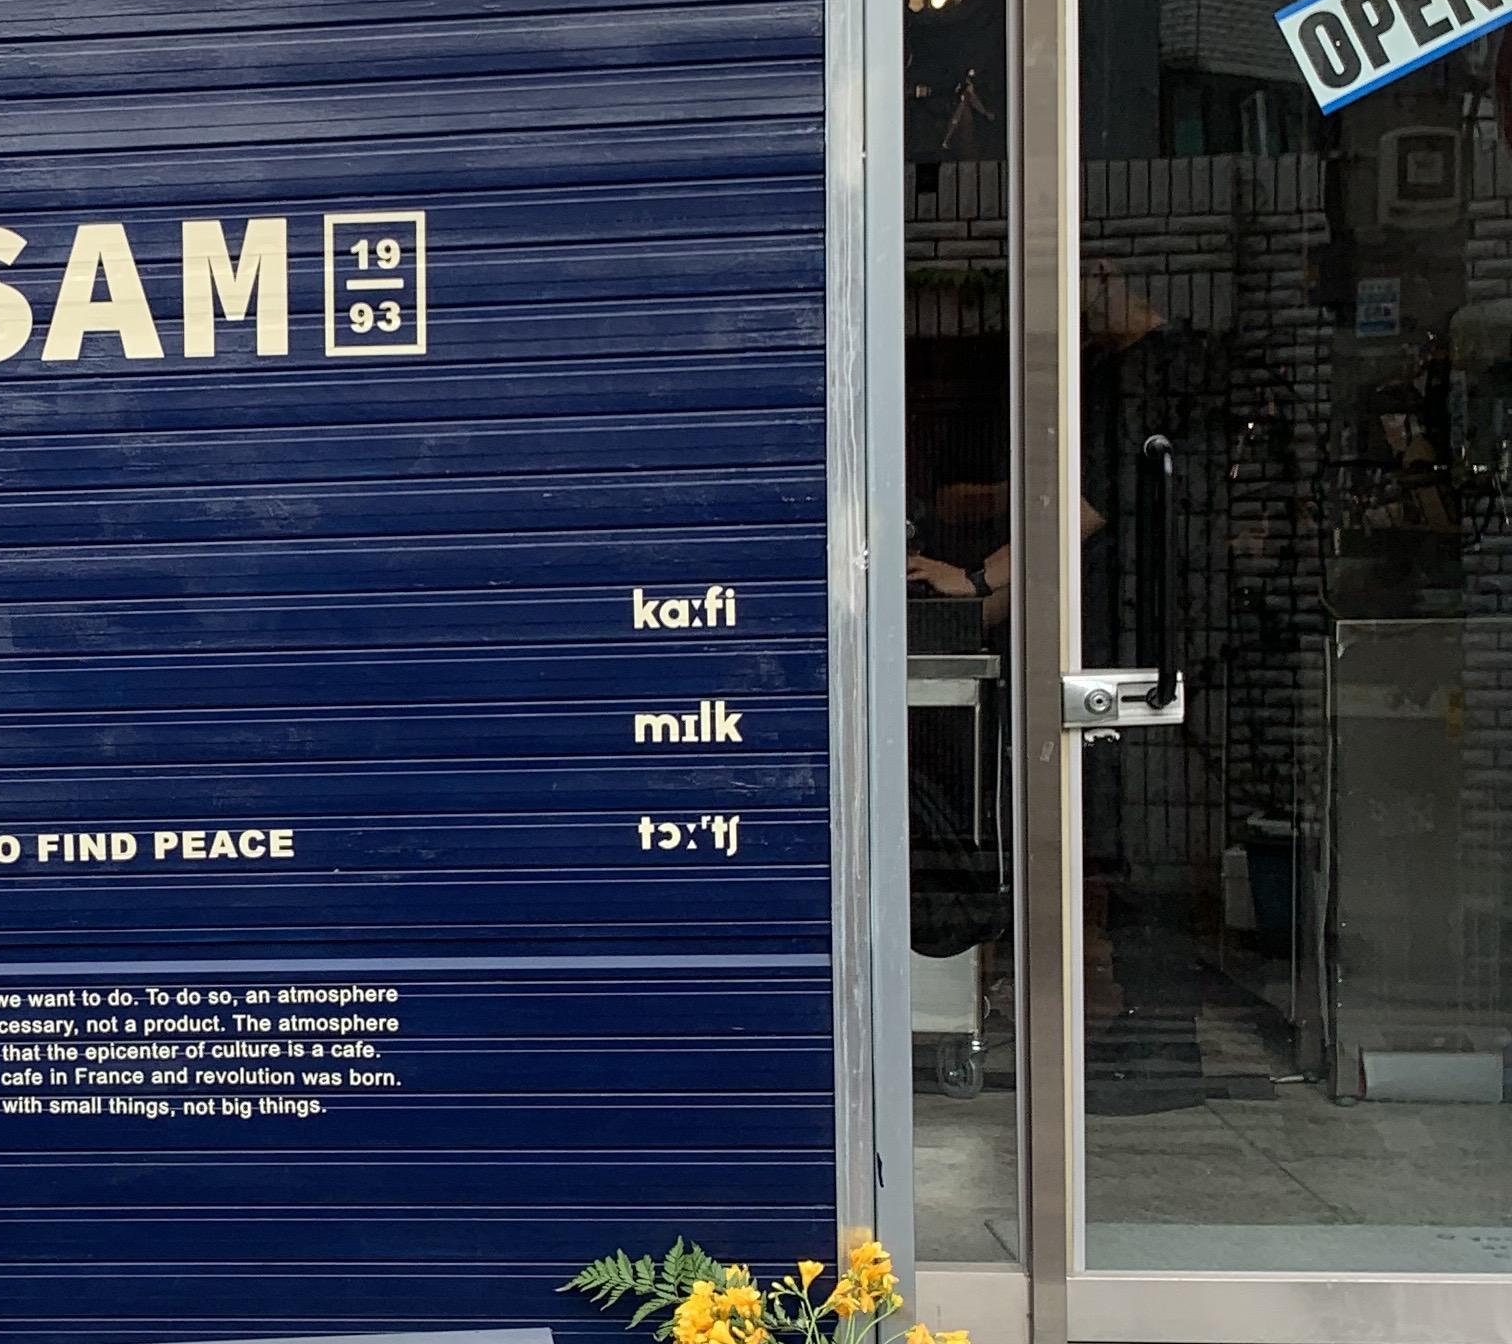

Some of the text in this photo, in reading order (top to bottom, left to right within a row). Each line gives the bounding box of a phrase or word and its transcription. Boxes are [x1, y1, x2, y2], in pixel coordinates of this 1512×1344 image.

[350, 238, 401, 270] 19
[349, 300, 402, 334] 93
[37, 832, 137, 862] FIND
[154, 828, 295, 860] PEACE
[28, 990, 76, 1007] want
[81, 990, 101, 1006] to
[107, 988, 138, 1006] do.
[145, 988, 170, 1006] To
[176, 987, 201, 1005] do
[208, 991, 238, 1006] so,
[245, 990, 270, 1004] an
[277, 984, 399, 1006] atmosphere
[86, 1017, 119, 1033] not
[124, 1019, 137, 1033] a
[144, 1015, 225, 1036] product.
[233, 1014, 272, 1032] The
[278, 1014, 399, 1035] atmosphere
[2, 1043, 41, 1062] that
[46, 1043, 79, 1061] the
[84, 1041, 179, 1064] epicenter
[185, 1040, 206, 1059] of
[211, 1040, 281, 1059] culture
[287, 1039, 305, 1057] is
[311, 1043, 324, 1058] a
[330, 1040, 380, 1058] cafe.
[1, 1068, 43, 1086] cafe
[50, 1069, 68, 1085] in
[75, 1067, 144, 1085] France
[151, 1067, 188, 1084] and
[195, 1067, 295, 1085] revolution
[302, 1072, 342, 1086] was
[349, 1069, 401, 1086] born.
[2, 1096, 43, 1114] with
[49, 1096, 102, 1114] small
[108, 1096, 175, 1119] things,
[183, 1098, 216, 1115] not
[221, 1097, 252, 1119] big
[258, 1096, 326, 1118] things.
